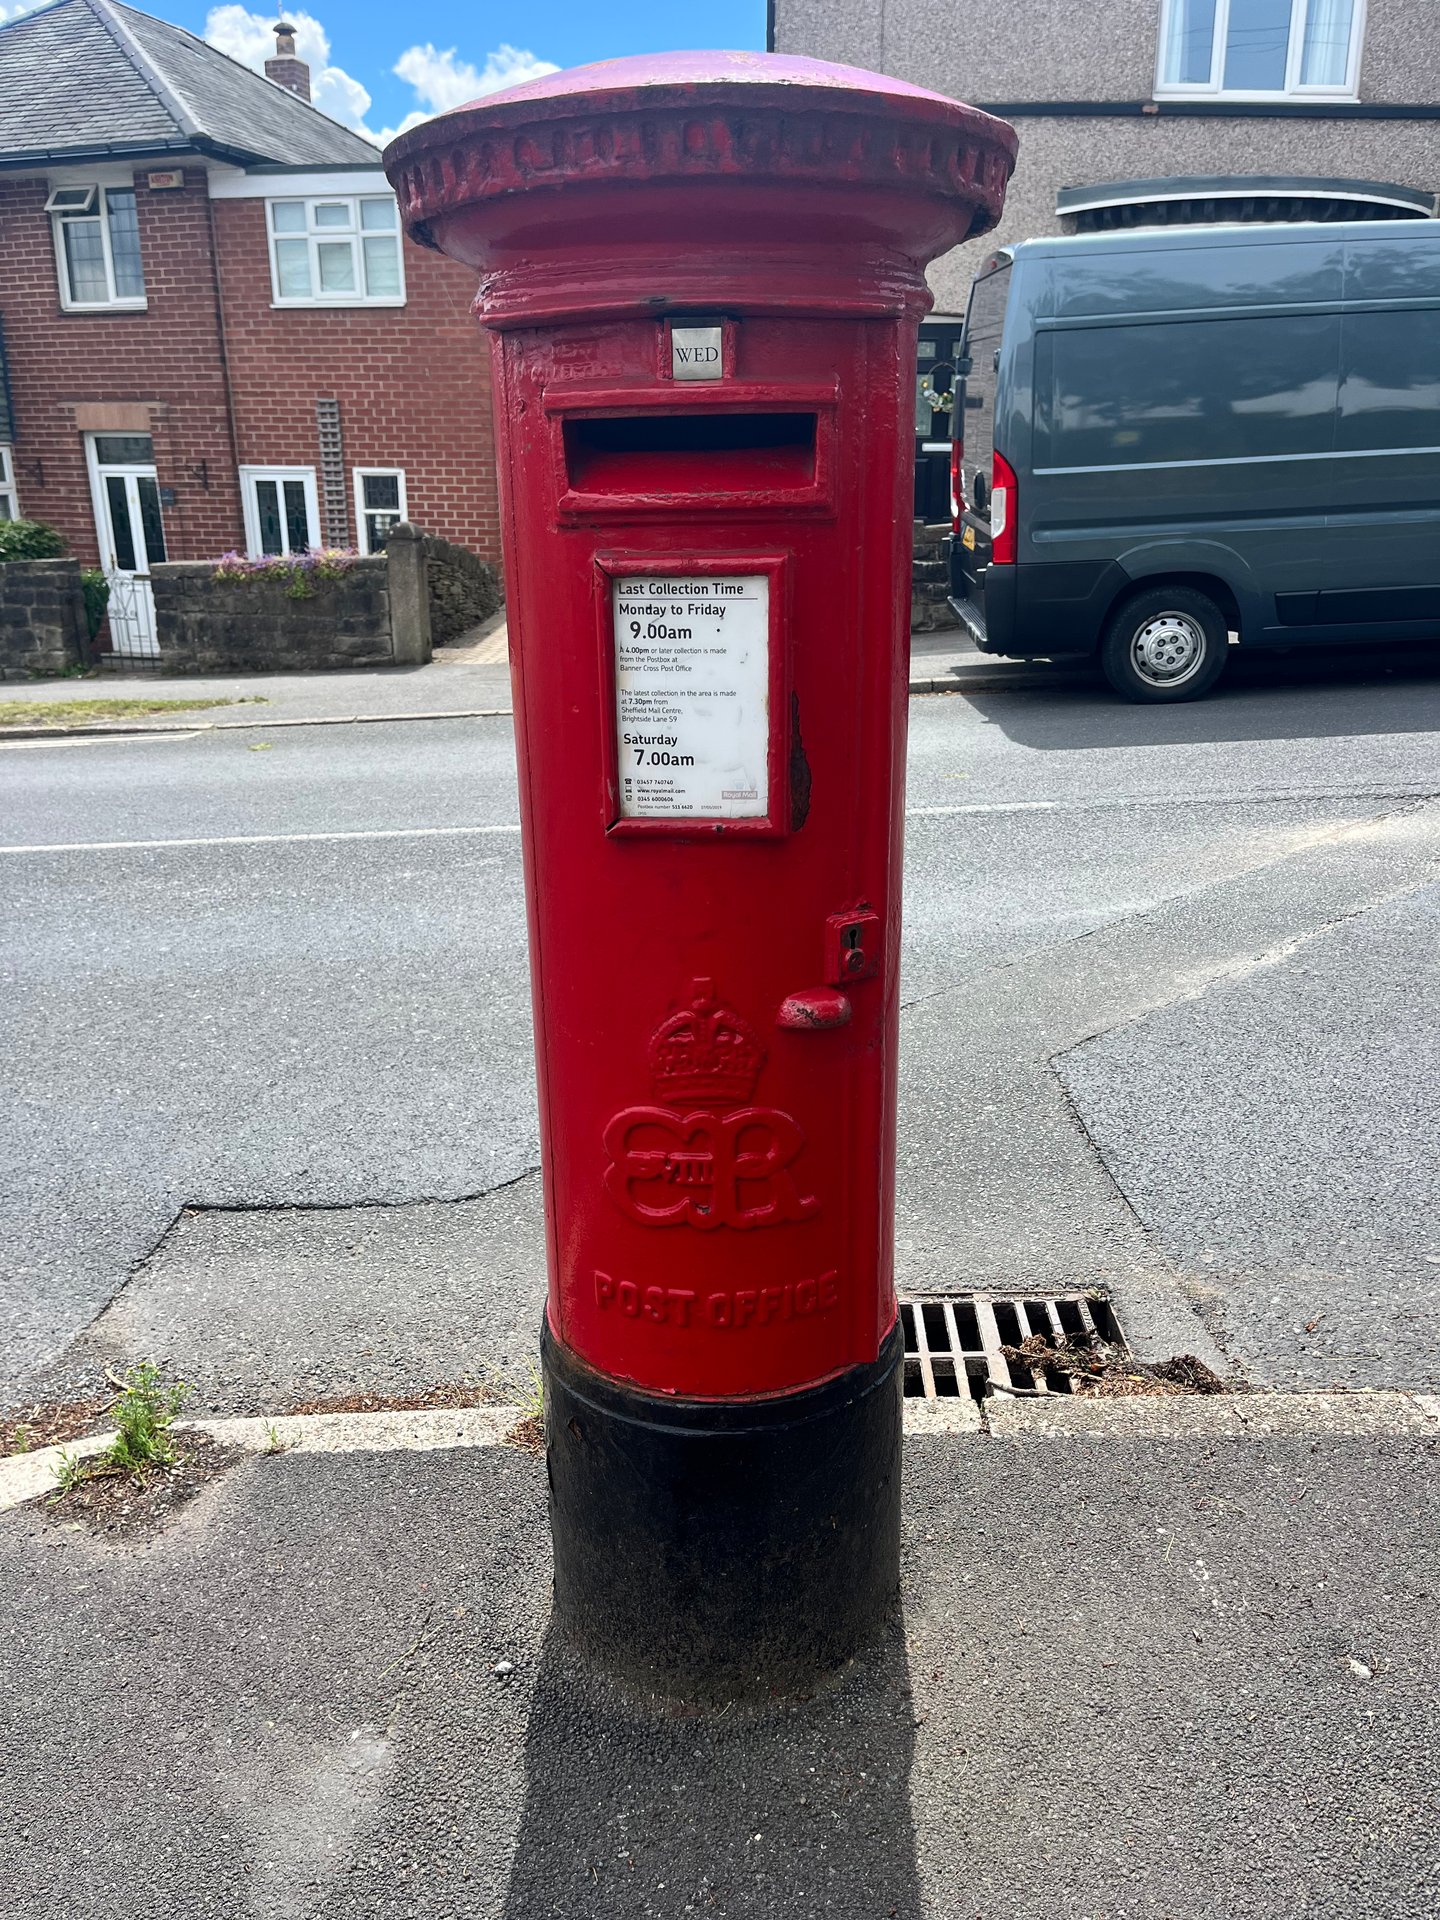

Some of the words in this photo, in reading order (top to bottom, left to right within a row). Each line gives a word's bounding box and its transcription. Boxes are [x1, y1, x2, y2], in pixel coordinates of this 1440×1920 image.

[675, 346, 719, 363] WED
[618, 583, 645, 595] Last
[649, 582, 709, 595] Collection
[712, 582, 744, 595] Time
[619, 603, 667, 618] Monday
[671, 604, 683, 615] to
[688, 603, 727, 618] Friday
[629, 620, 692, 639] 9.00am
[626, 647, 650, 655] 4.00pm
[621, 689, 633, 697] The
[634, 689, 650, 697] latest
[651, 689, 679, 697] collection
[680, 689, 686, 697] in
[686, 689, 697, 697] the
[713, 689, 718, 697] is
[719, 689, 737, 697] made
[628, 698, 652, 707] 7.30pm
[662, 707, 683, 715] Centre,
[623, 733, 678, 747] Saturday
[634, 749, 695, 766] 7.00am
[723, 791, 742, 799] Royal
[594, 1269, 696, 1327] POST
[706, 1269, 839, 1328] OFFICE
